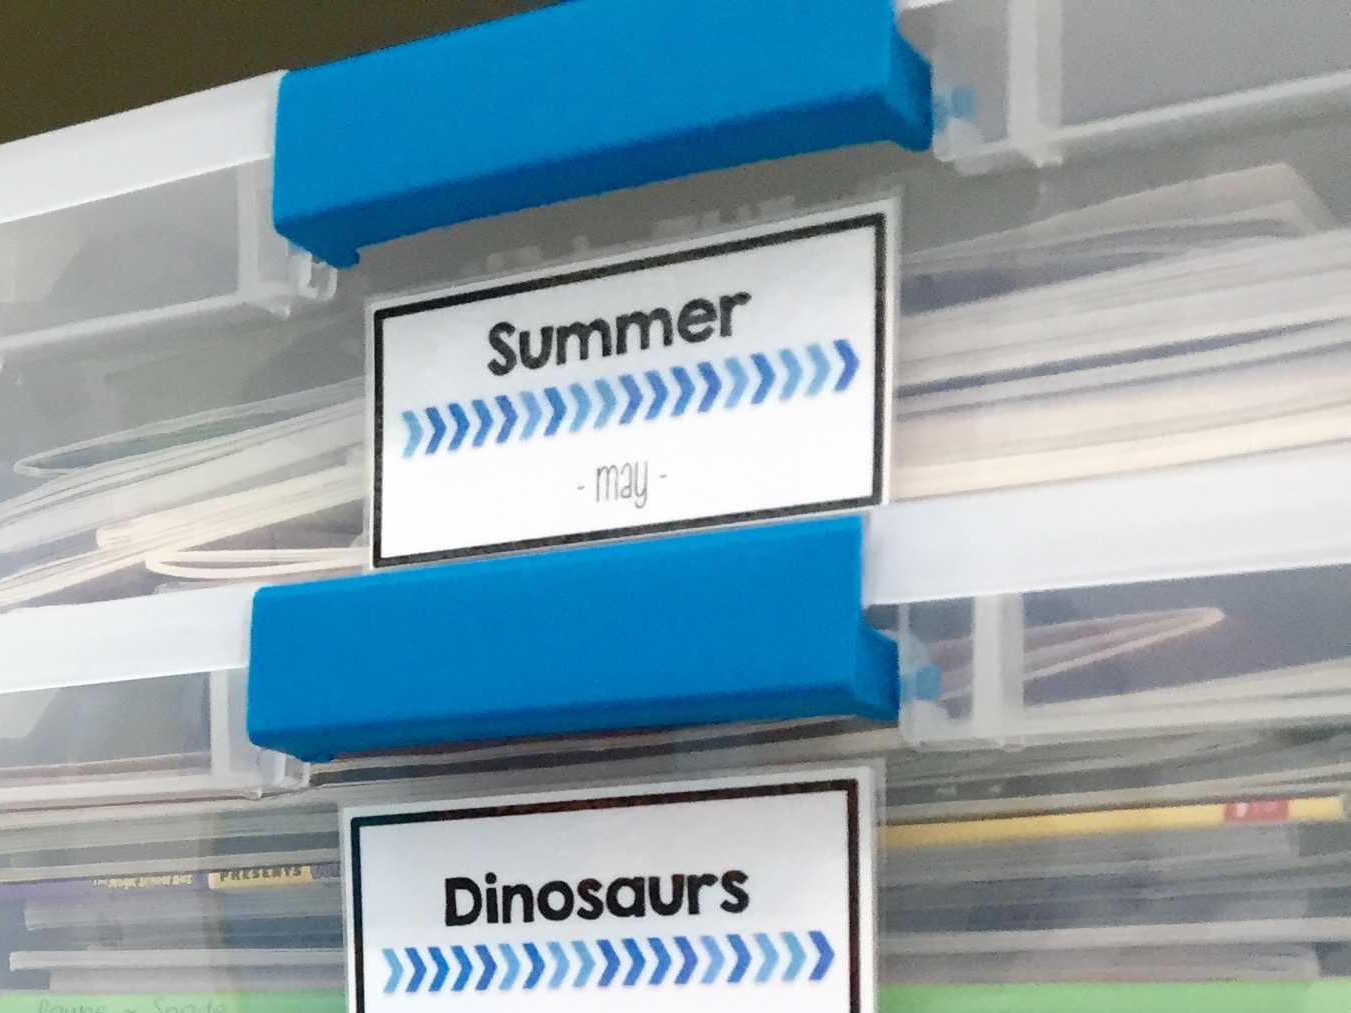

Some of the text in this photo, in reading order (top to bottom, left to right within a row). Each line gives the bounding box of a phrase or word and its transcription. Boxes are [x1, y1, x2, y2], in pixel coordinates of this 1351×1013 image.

[487, 290, 753, 377] Summer
[595, 461, 649, 509] may
[444, 869, 750, 928] Dinosaurs
